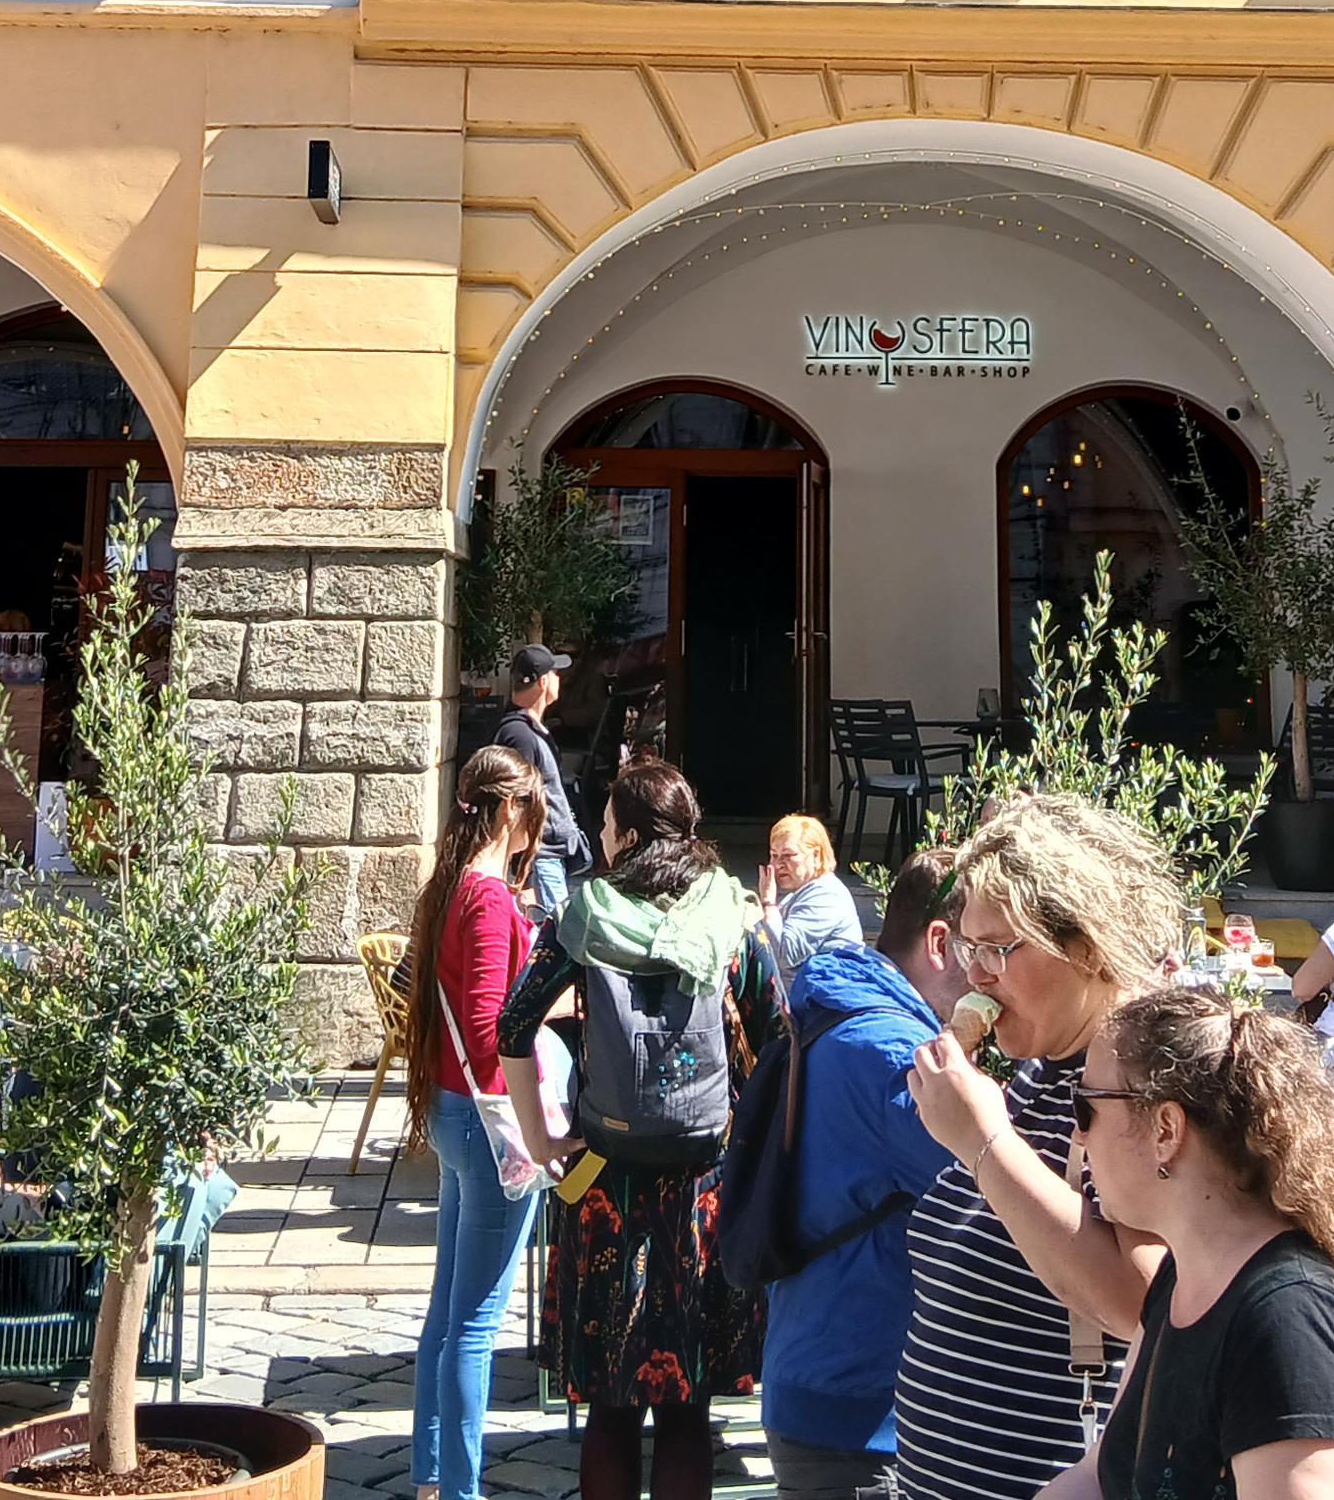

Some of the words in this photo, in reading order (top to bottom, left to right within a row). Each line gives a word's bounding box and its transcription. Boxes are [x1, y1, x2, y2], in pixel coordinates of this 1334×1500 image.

[805, 363, 852, 376] CAFE
[930, 365, 966, 377] BAR
[980, 365, 1031, 378] SHOP
